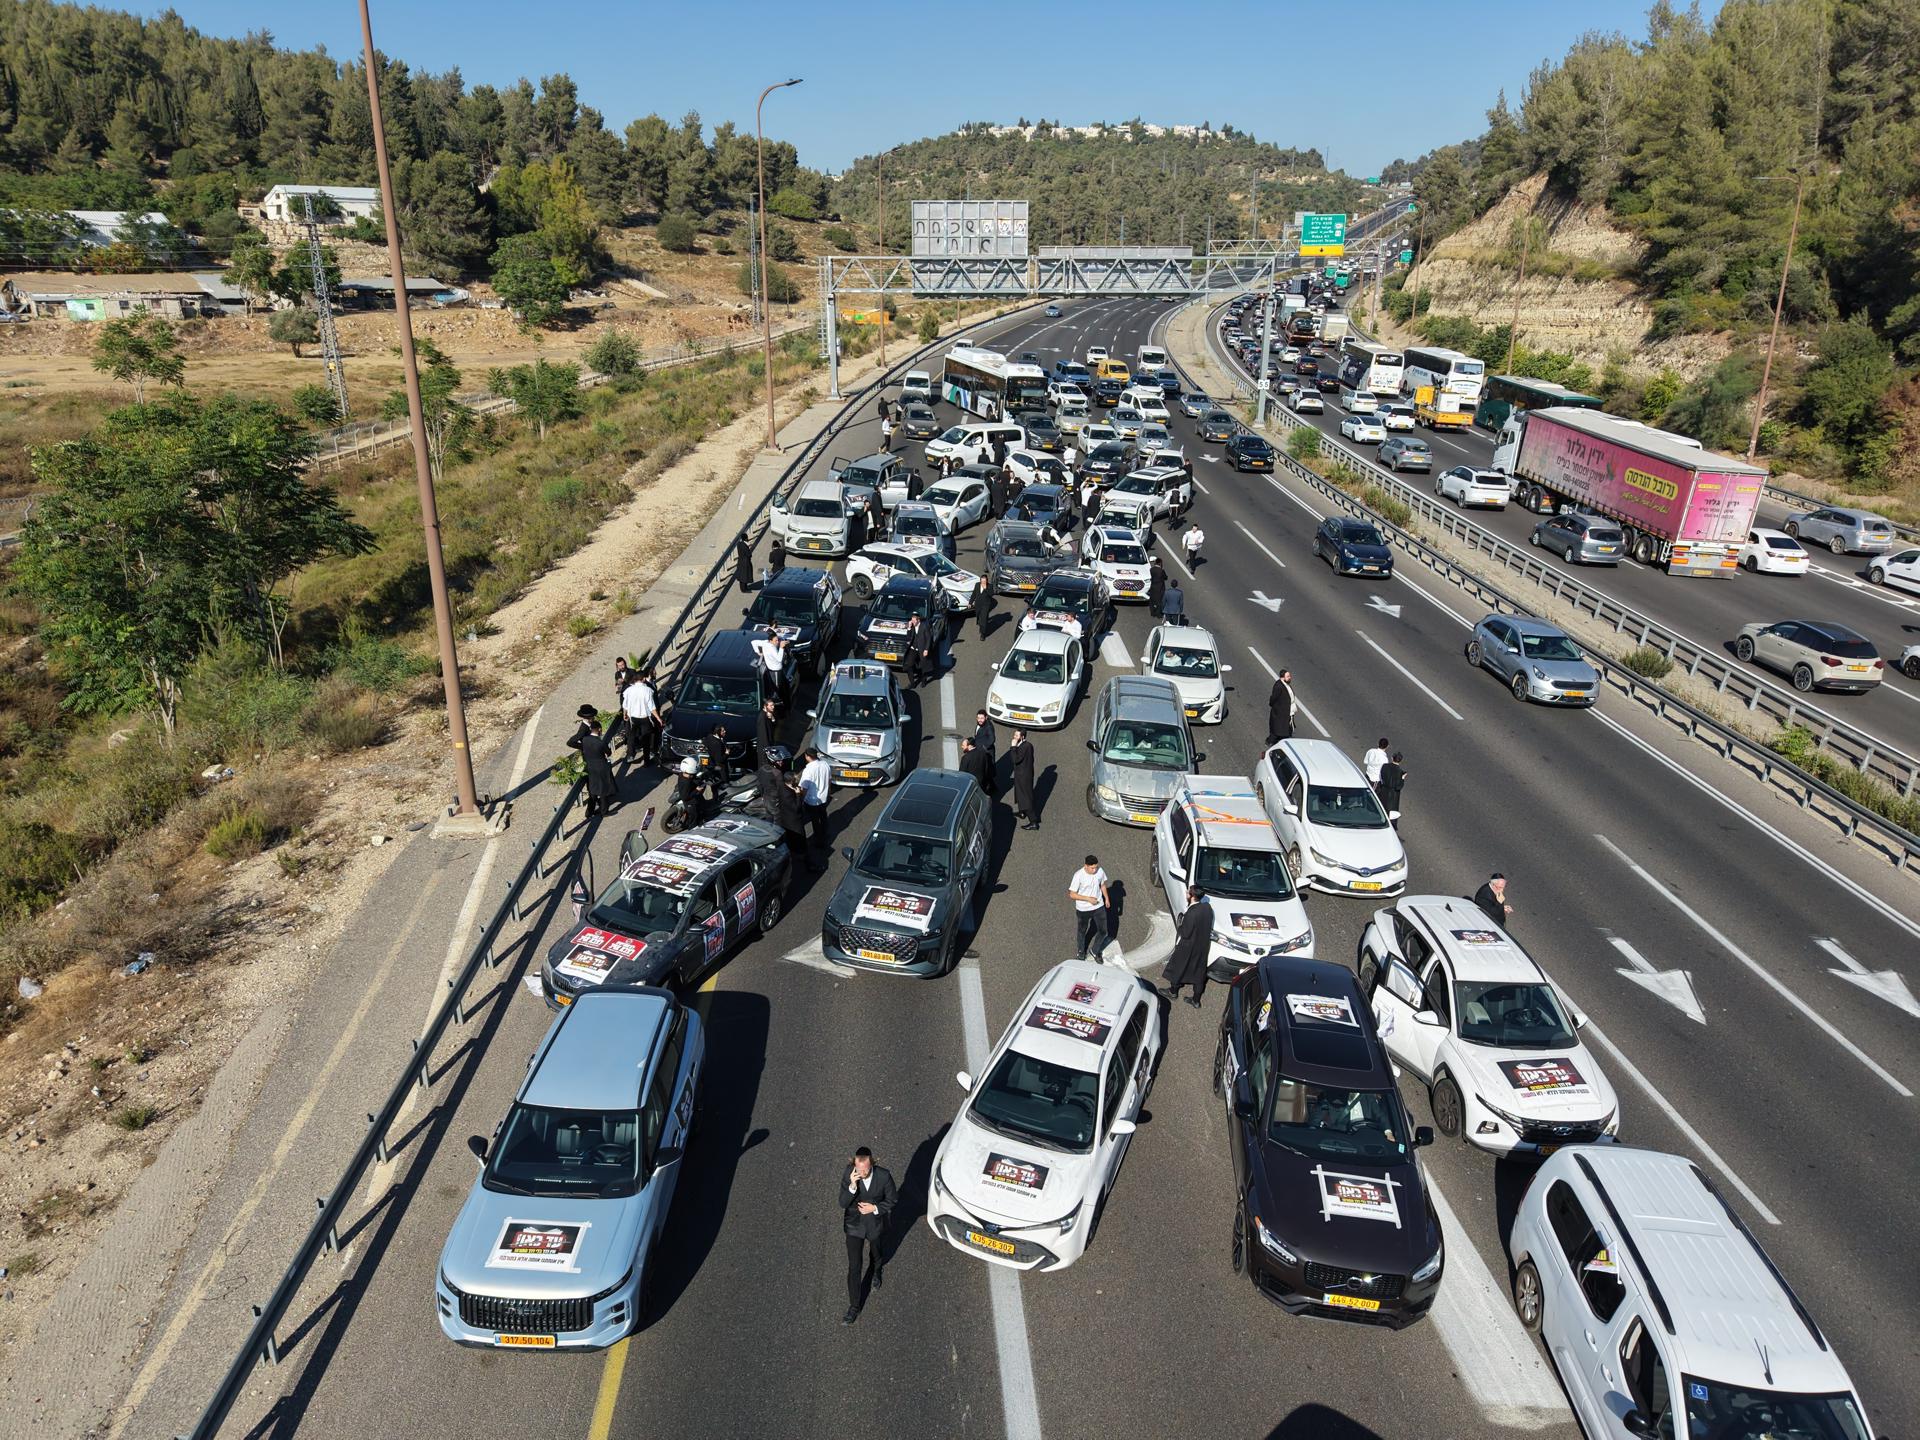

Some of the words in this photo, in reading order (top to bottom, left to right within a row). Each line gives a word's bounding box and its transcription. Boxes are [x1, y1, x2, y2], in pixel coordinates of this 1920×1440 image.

[914, 220, 975, 236] שכחת
[936, 238, 991, 254] אותי
[1626, 469, 1653, 489] הנדסה
[1654, 478, 1676, 498] גלובל
[1552, 1067, 1571, 1082] עד
[1021, 1168, 1037, 1184] עד
[1359, 1186, 1381, 1201] עד
[545, 1236, 564, 1249] עד
